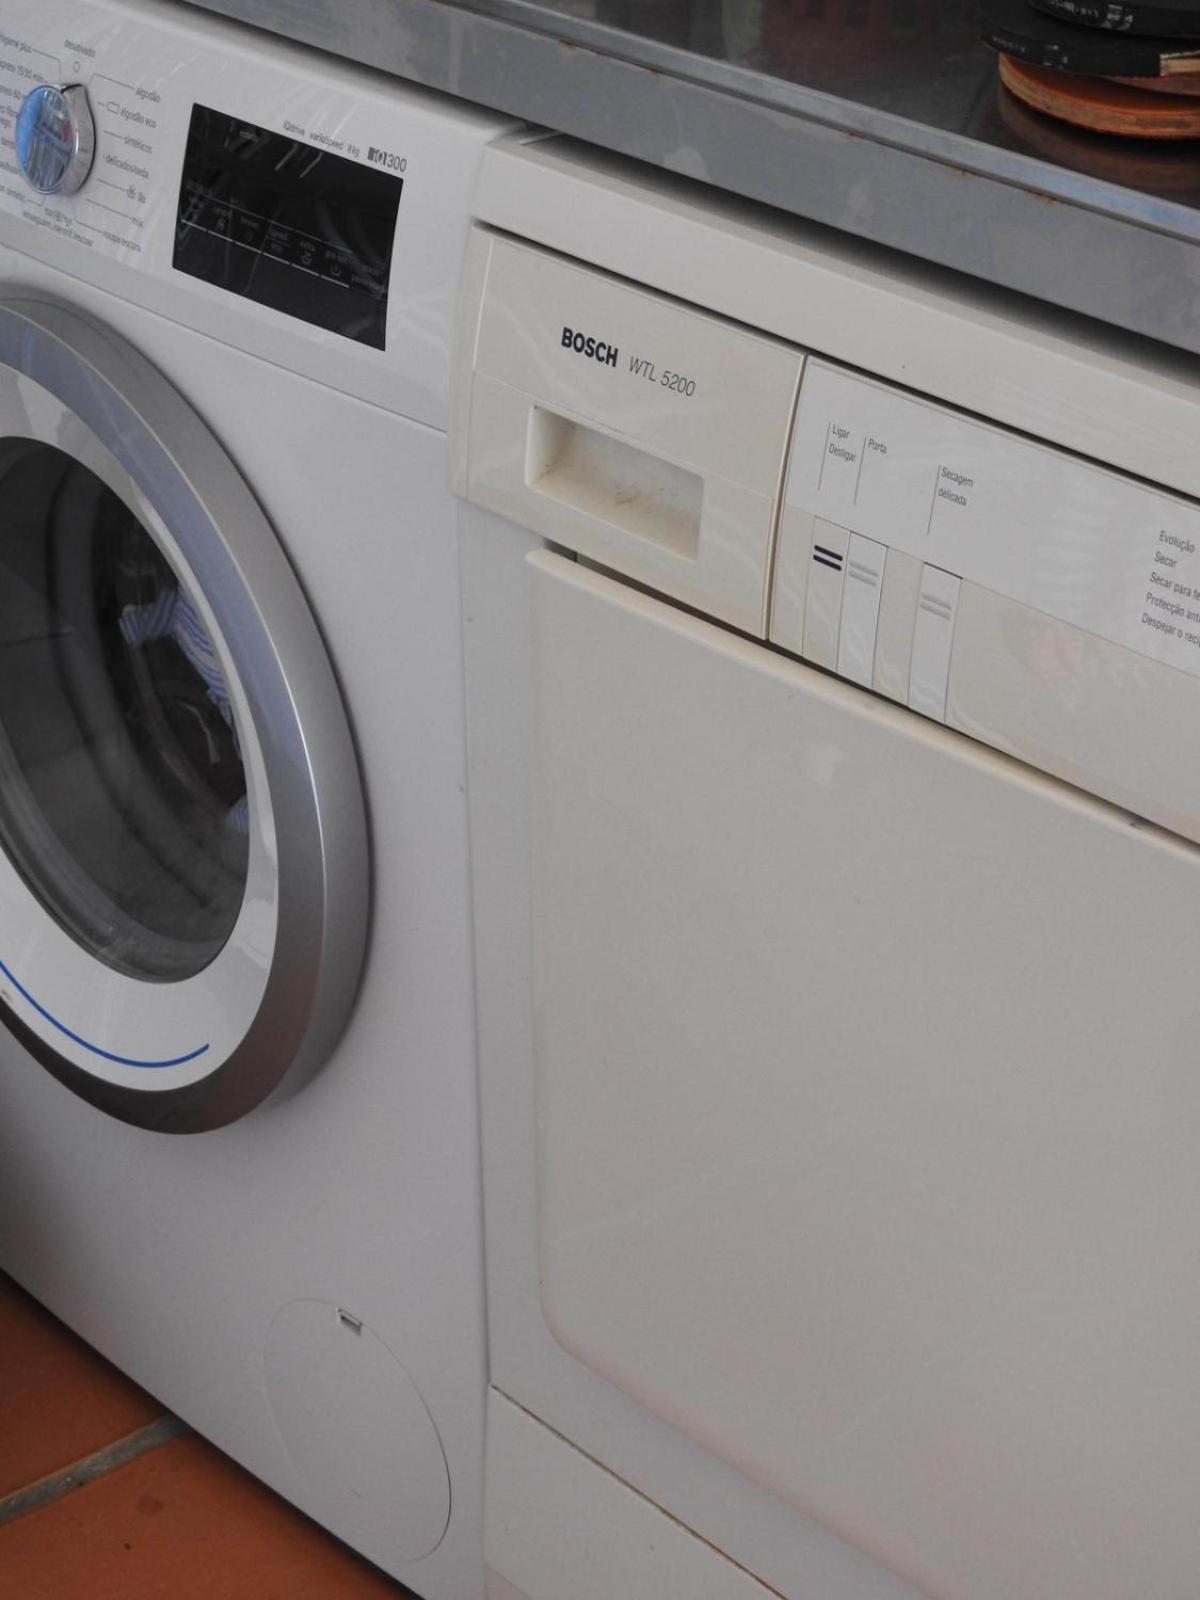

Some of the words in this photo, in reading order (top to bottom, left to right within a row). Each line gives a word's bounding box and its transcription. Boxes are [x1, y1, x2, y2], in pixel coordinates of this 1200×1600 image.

[561, 326, 618, 368] BOSCH
[628, 355, 656, 382] WTL
[660, 370, 697, 397] 5200
[832, 424, 850, 439] Ligar
[828, 443, 856, 462] Desligar
[867, 438, 887, 454] Porta
[941, 467, 974, 487] Secagem
[938, 487, 967, 507] delicada
[1159, 530, 1195, 553] Evolução
[1155, 551, 1178, 568] Secar
[1150, 572, 1172, 588] Secar
[1173, 582, 1192, 598] para
[1146, 592, 1185, 615] Protecção
[1141, 612, 1176, 634] Despejar
[1176, 628, 1183, 639] o
